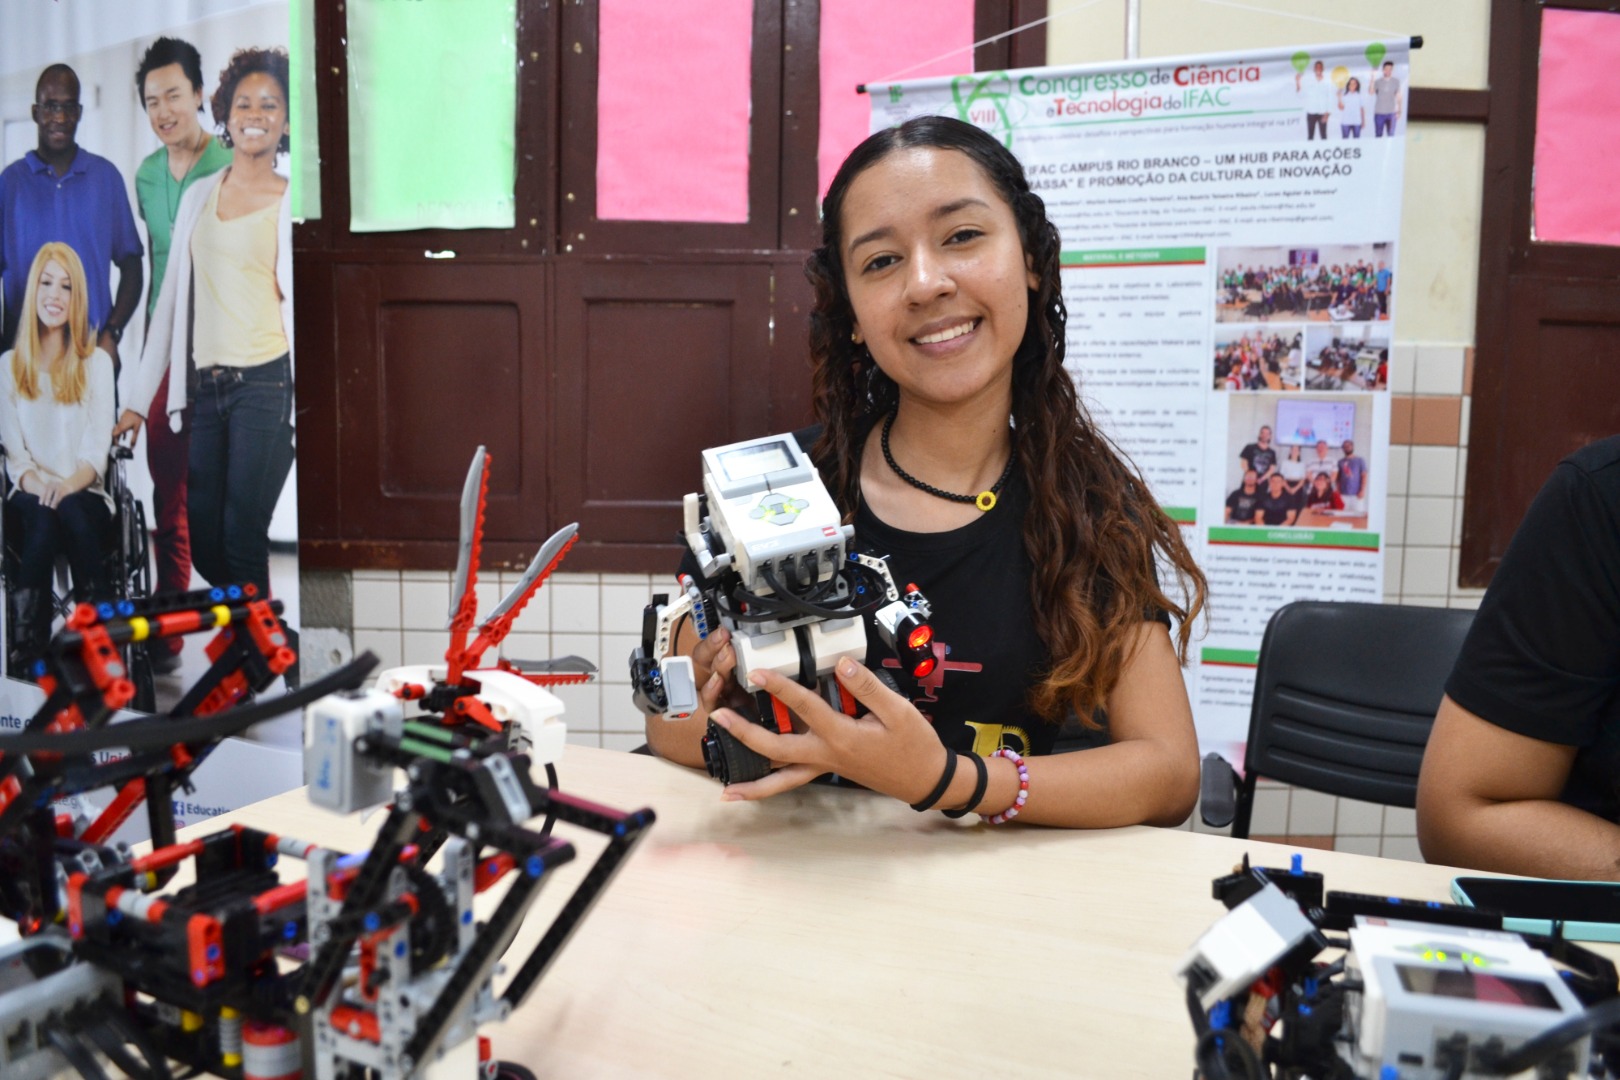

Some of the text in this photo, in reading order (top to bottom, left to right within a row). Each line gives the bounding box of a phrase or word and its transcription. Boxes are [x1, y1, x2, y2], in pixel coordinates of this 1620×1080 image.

[1018, 60, 1261, 101] Congresso de Ciência
[970, 108, 997, 124] VIII
[1053, 89, 1162, 118] Tecnologia
[1163, 94, 1182, 111] do
[1183, 86, 1232, 109] IFAC
[1028, 163, 1058, 175] IFAC
[1059, 160, 1114, 174] CAMPUS
[1117, 158, 1140, 171] RIO
[1143, 155, 1200, 170] BRANCO
[1215, 153, 1236, 166] UM
[1239, 151, 1269, 164] HUB
[1272, 149, 1310, 163] PARA
[1312, 146, 1362, 162] AÇÕES
[1076, 177, 1086, 188] E
[1088, 172, 1166, 188] PROMOÇÃO
[1168, 172, 1188, 184] DA
[1190, 168, 1254, 183] CULTURA
[1257, 167, 1276, 179] DE
[1279, 163, 1353, 179] INOVAÇÃO
